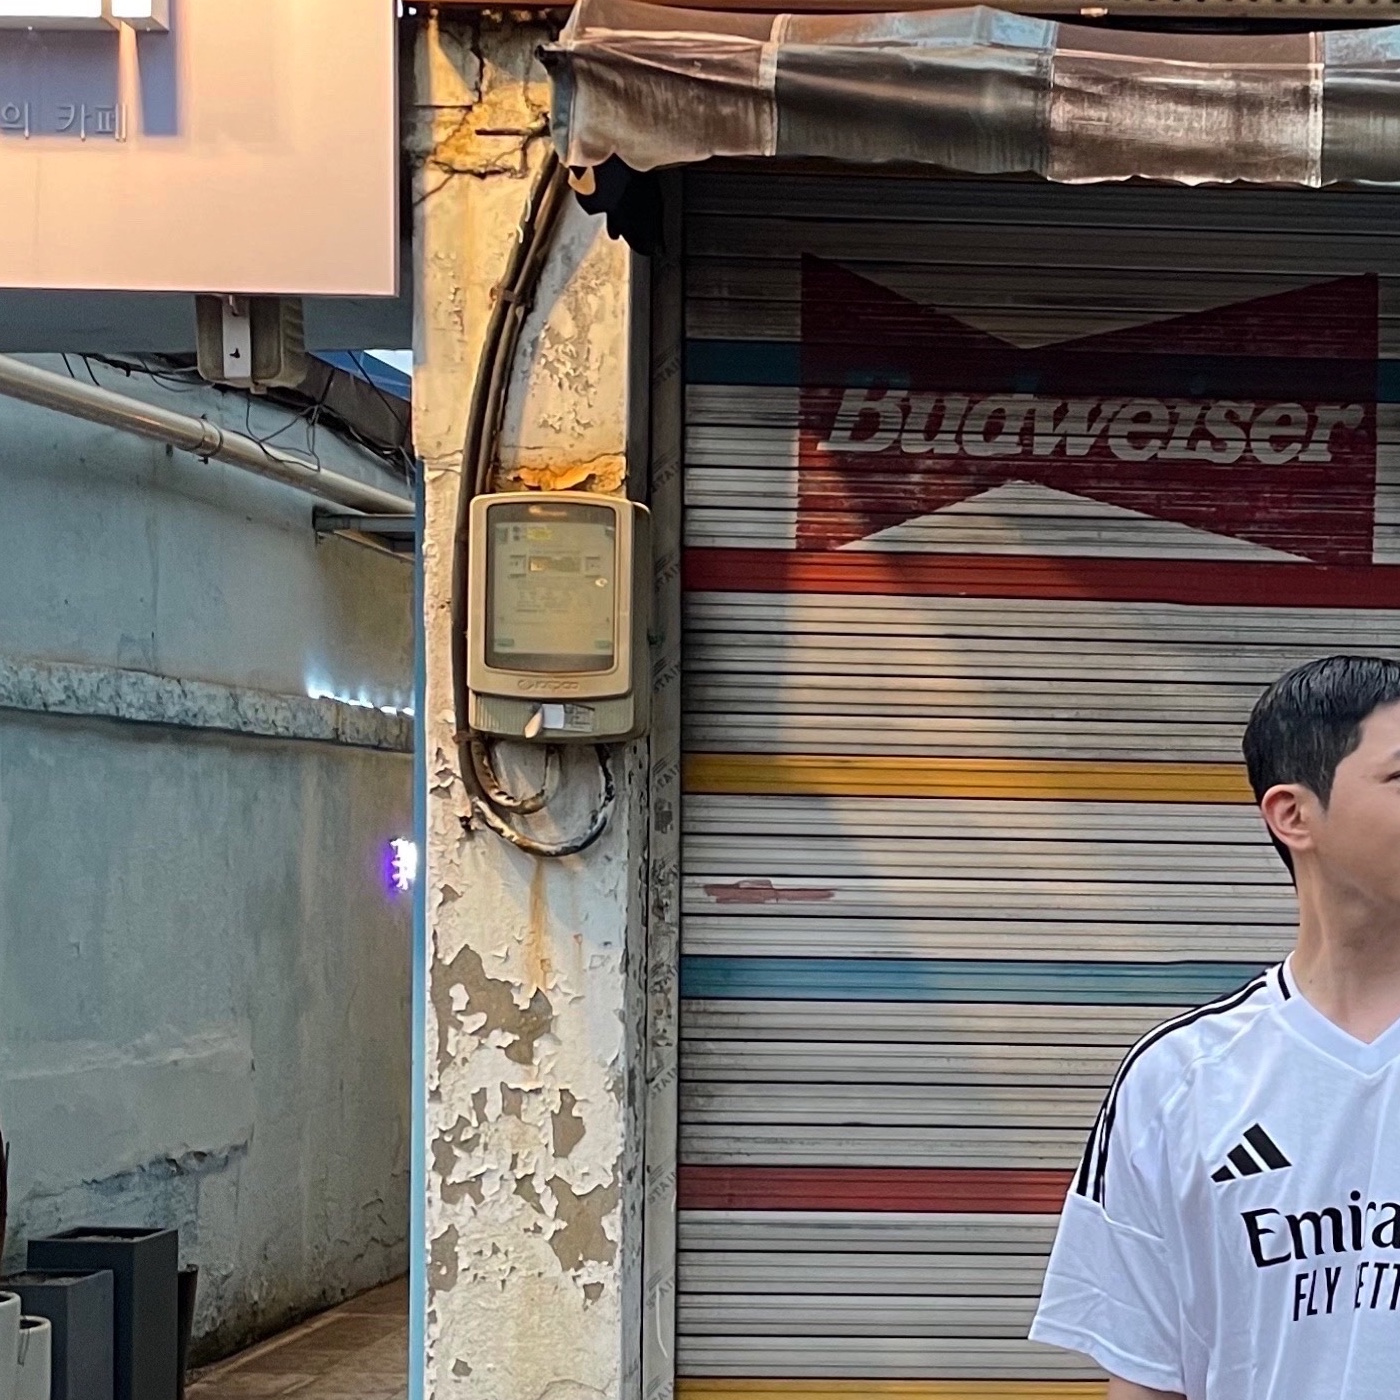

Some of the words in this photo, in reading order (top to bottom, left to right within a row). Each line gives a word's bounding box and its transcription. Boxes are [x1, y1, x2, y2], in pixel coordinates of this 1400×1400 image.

[57, 103, 126, 141] 카페
[817, 371, 1364, 465] Budweiser
[1293, 1266, 1341, 1321] FLY
